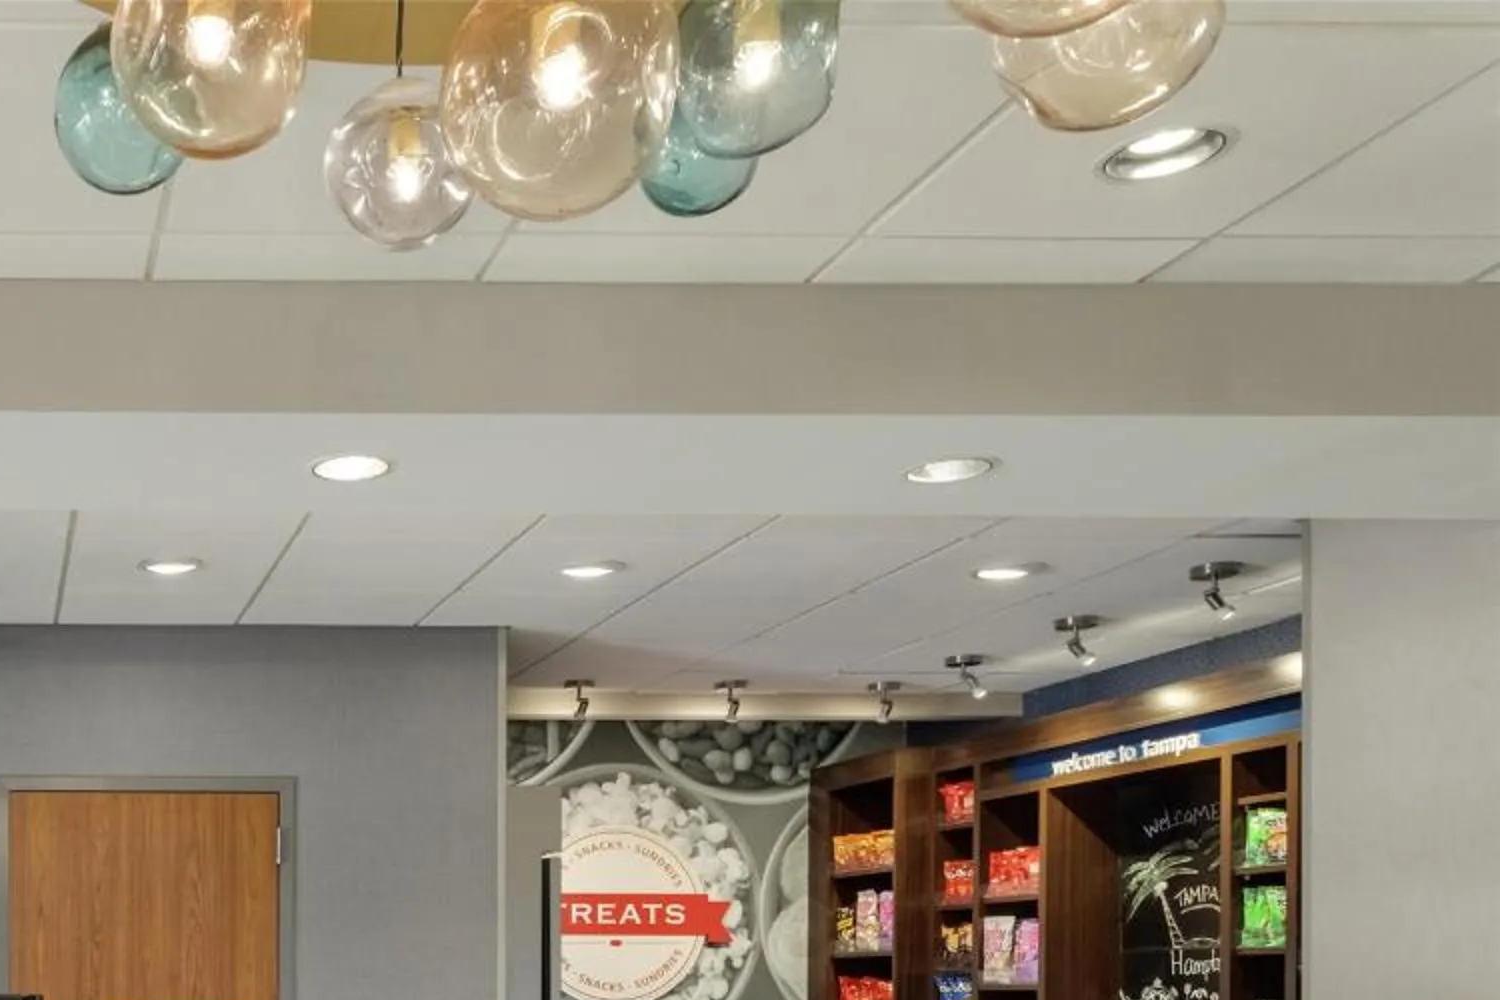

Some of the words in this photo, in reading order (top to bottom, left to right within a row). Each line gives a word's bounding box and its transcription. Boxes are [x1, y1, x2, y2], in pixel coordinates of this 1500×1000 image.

[1051, 752, 1116, 775] welcome
[1117, 744, 1137, 763] to
[1141, 732, 1200, 757] tampa
[1173, 884, 1221, 908] TAMPA
[561, 903, 686, 925] REATS
[1170, 948, 1221, 982] Hampto
[579, 973, 625, 992] SNACKS
